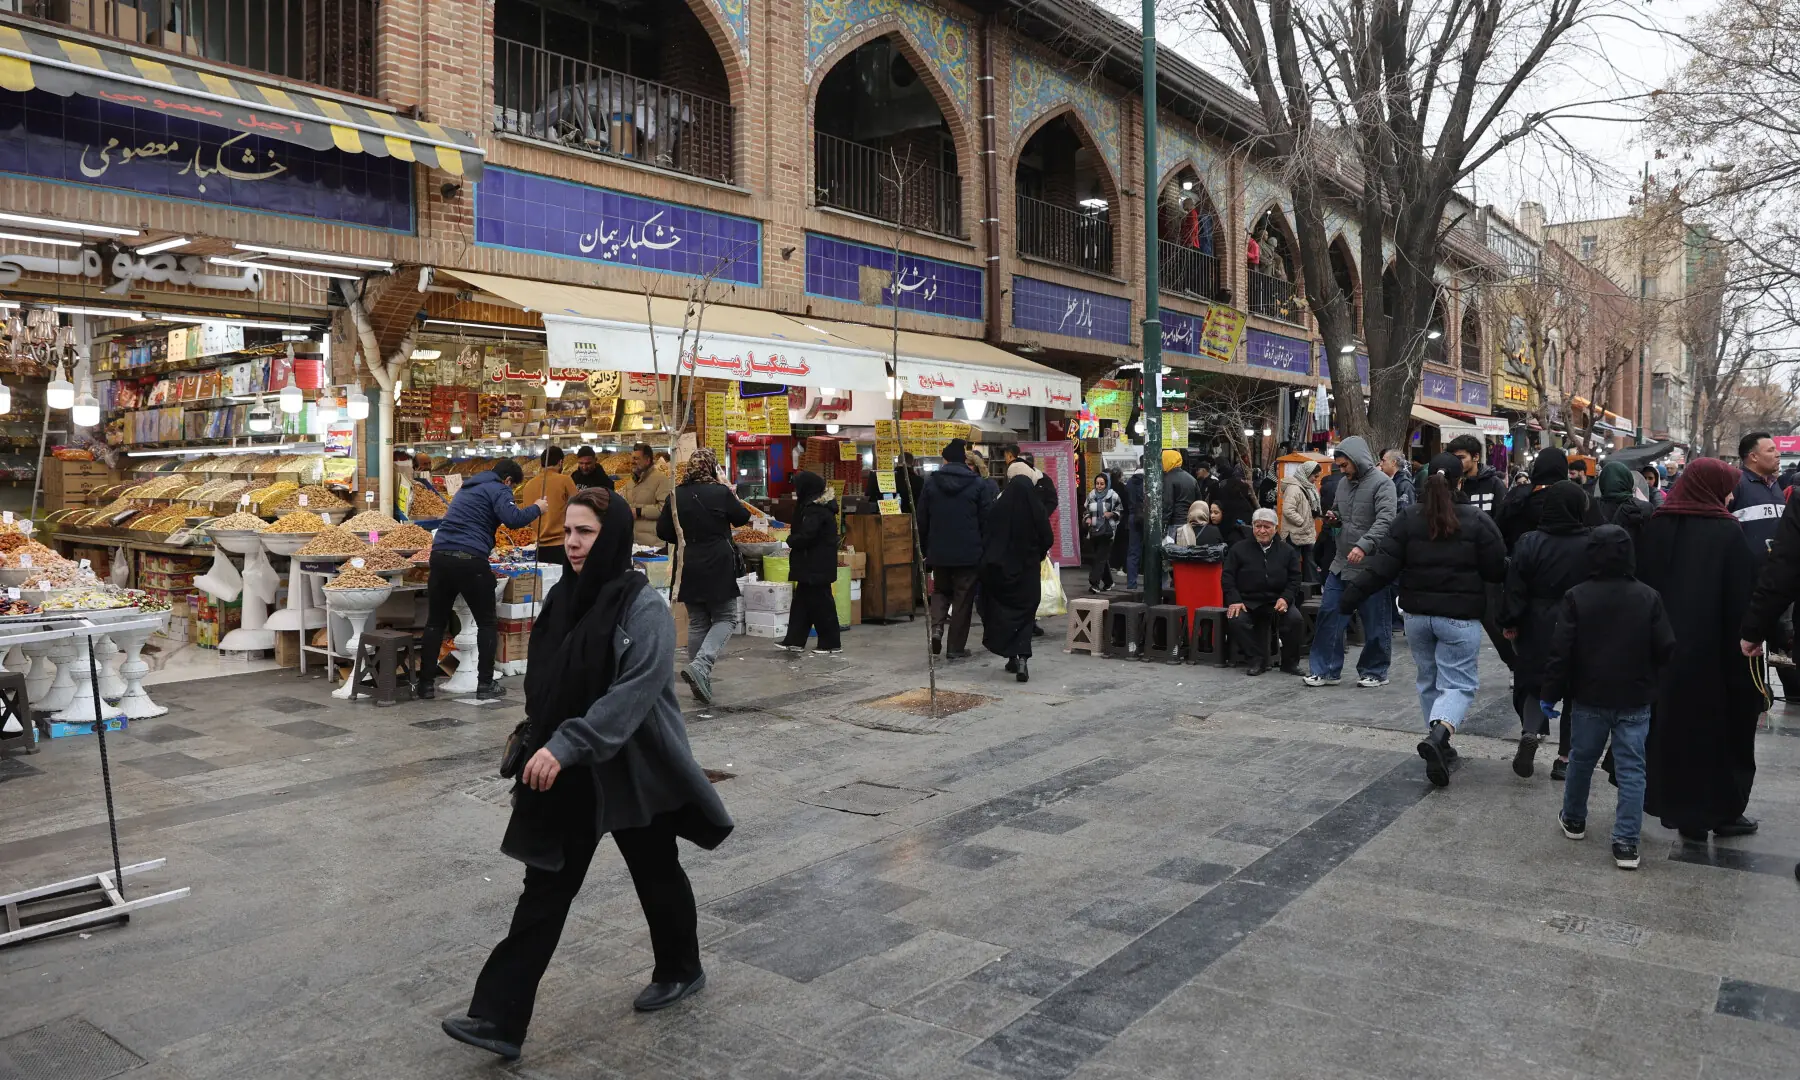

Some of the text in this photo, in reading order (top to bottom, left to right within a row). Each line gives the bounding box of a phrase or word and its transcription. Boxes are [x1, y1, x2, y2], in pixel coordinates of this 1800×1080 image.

[238, 114, 304, 134] آجیل
[79, 131, 287, 194] خشکبار معصومی
[579, 210, 682, 259] خشکبار پیمان
[890, 267, 937, 300] فروشگاه
[1076, 297, 1093, 336] بازار
[490, 362, 543, 388] پیمان
[744, 351, 811, 379] خشکبار
[971, 379, 1004, 397] انفجار
[1007, 385, 1032, 400] امیر
[1045, 385, 1073, 408] پیتزا
[1763, 506, 1772, 516] 76
